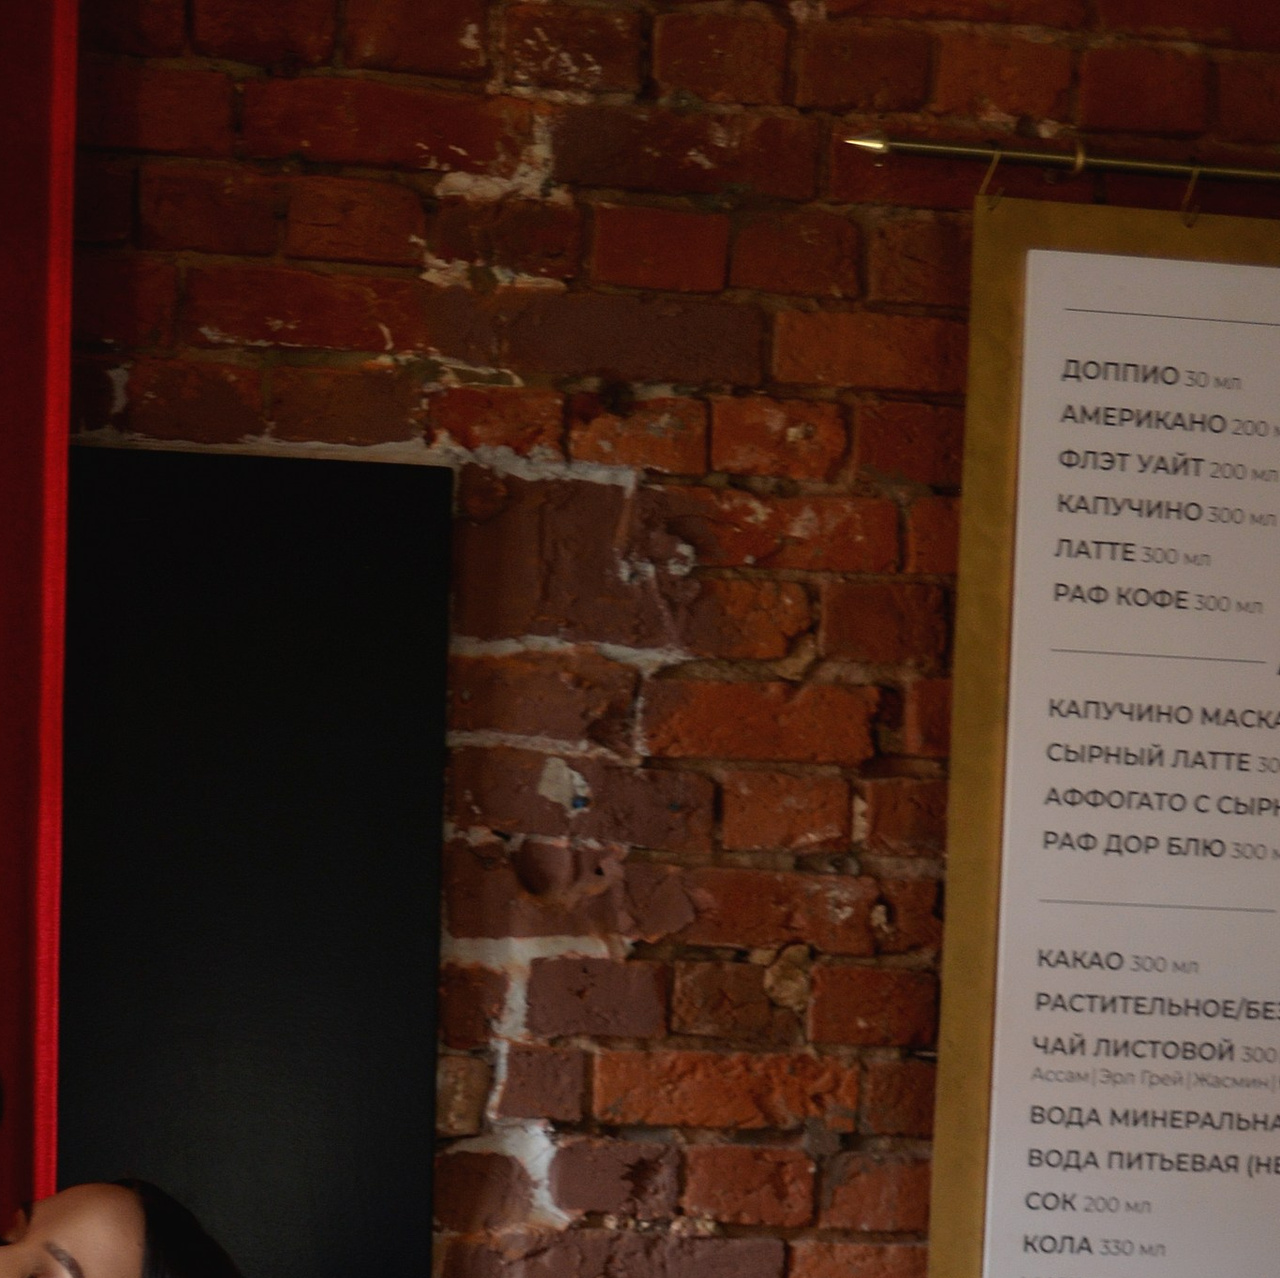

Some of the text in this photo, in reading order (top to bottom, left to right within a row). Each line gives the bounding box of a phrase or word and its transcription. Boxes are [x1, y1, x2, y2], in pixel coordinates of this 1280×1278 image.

[1061, 359, 1241, 390] ДОППИО 30 мл
[1060, 404, 1227, 434] АМЕРИКАНО
[1231, 418, 1270, 437] 200
[1058, 449, 1279, 482] ФЛЭТ УАЙТ 200 мл
[1058, 494, 1277, 526] КАПУЧИНО 300 мл
[1054, 538, 1211, 566] ЛАТТЕ 300 мл
[1054, 583, 1263, 614] РАФ КОФЕ 300 мл
[1049, 699, 1193, 725] КАПУЧИНО
[1046, 743, 1164, 767] СЫРНЫЙ
[1171, 749, 1251, 772] ЛАТТЕ
[1044, 787, 1187, 812] АФФОГАТО
[1193, 794, 1210, 814] С
[1043, 831, 1098, 852] РАФ
[1103, 834, 1160, 856] ДОР
[1167, 837, 1226, 858] БЛЮ
[1230, 842, 1268, 860] 300
[1038, 949, 1199, 974] КАКАО 300 мл
[1035, 992, 1280, 1020] РАСТИТЕЛЬНОЕ/БЕ
[1033, 1033, 1278, 1063] ЧАЙ ЛИСТОВОЙ 300
[1030, 1105, 1102, 1129] ВОДА
[1028, 1148, 1099, 1172] ВОДА
[1107, 1151, 1239, 1173] ПИТЬЕВАЯ
[1025, 1191, 1152, 1214] СОК 200 мл
[1023, 1235, 1166, 1257] КОЛА 330 мл
